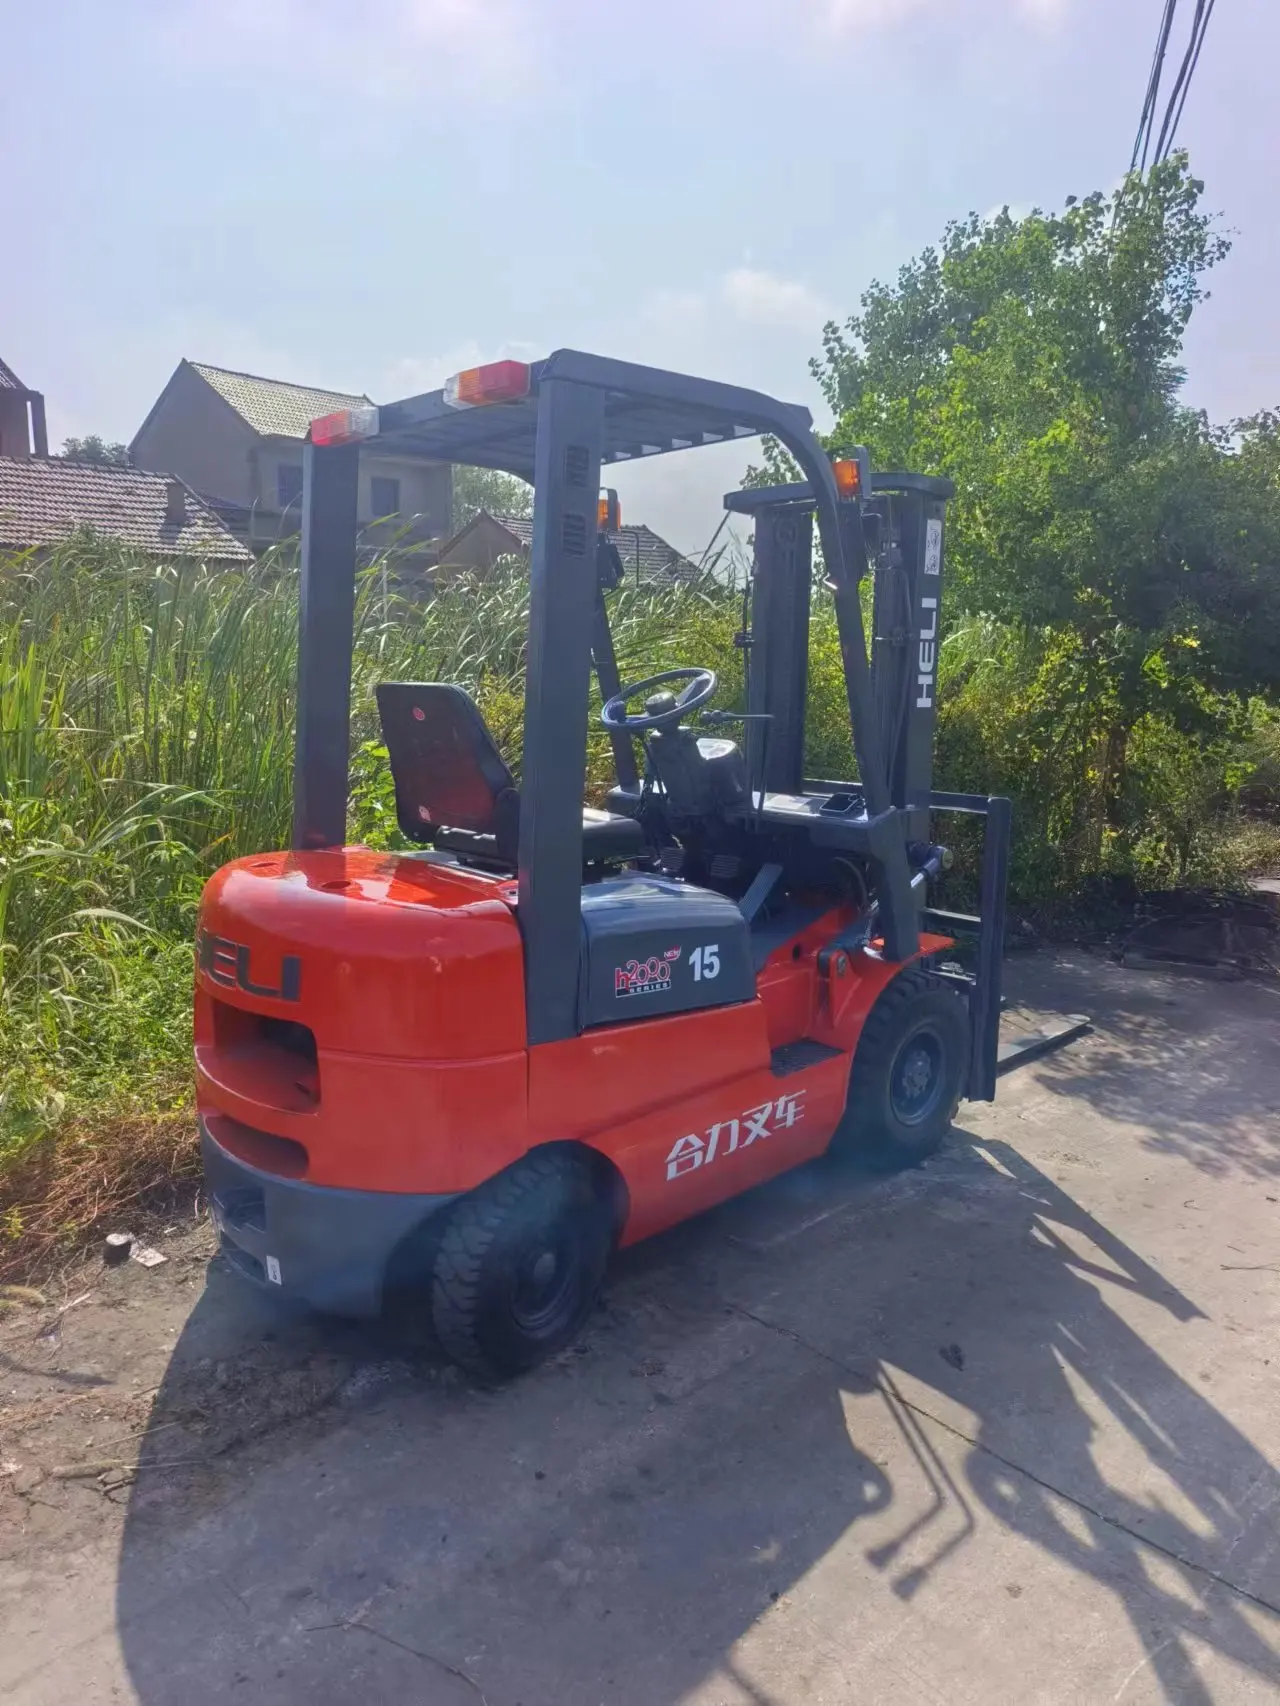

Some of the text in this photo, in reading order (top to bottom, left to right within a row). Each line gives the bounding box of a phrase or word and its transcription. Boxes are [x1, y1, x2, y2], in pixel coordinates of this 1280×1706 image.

[917, 598, 937, 708] HELI
[689, 944, 720, 982] 15
[664, 1089, 806, 1181] 合力叉车
